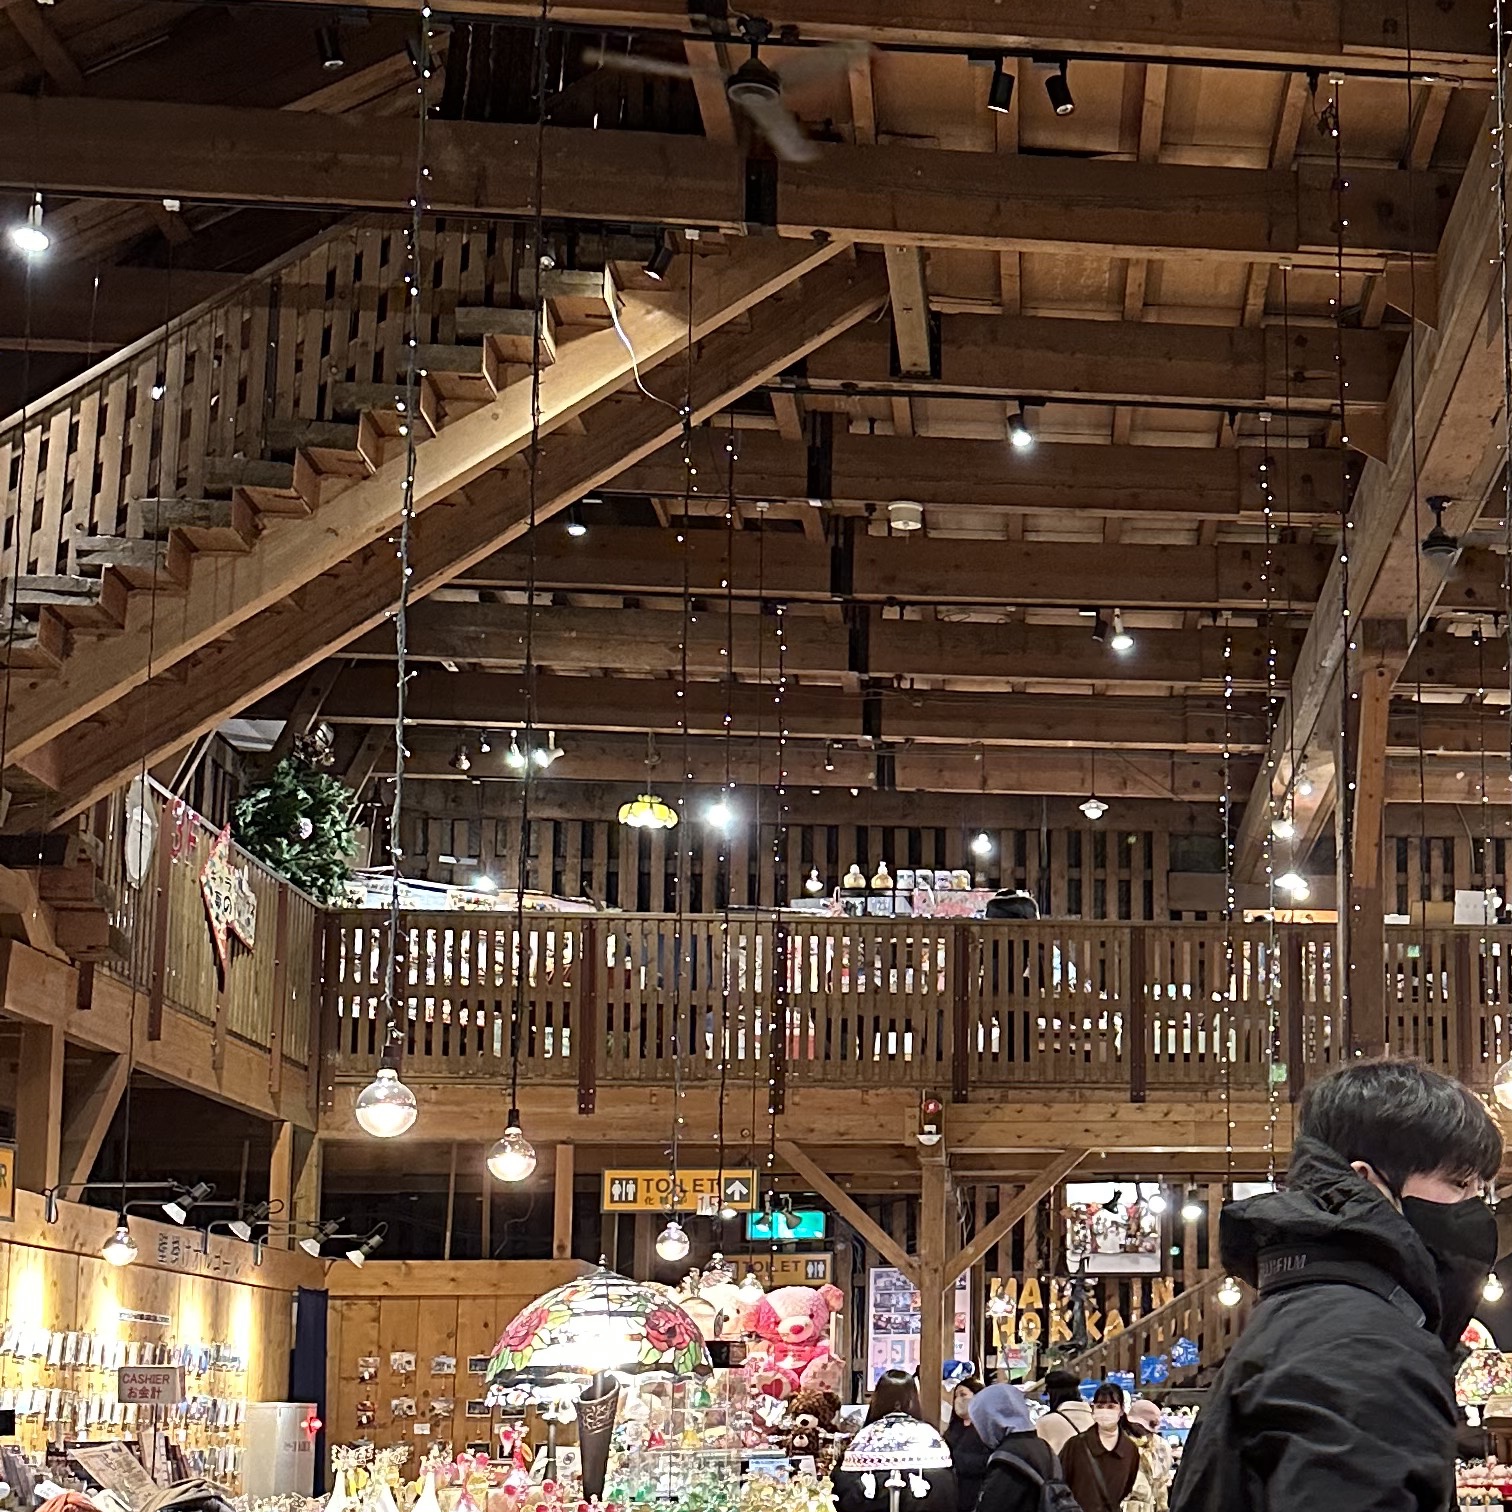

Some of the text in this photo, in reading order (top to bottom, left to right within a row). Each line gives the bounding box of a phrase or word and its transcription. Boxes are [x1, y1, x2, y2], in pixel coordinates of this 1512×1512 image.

[642, 1178, 720, 1194] TOLET
[122, 1373, 170, 1384] CASHIER
[128, 1386, 162, 1400] お会計
